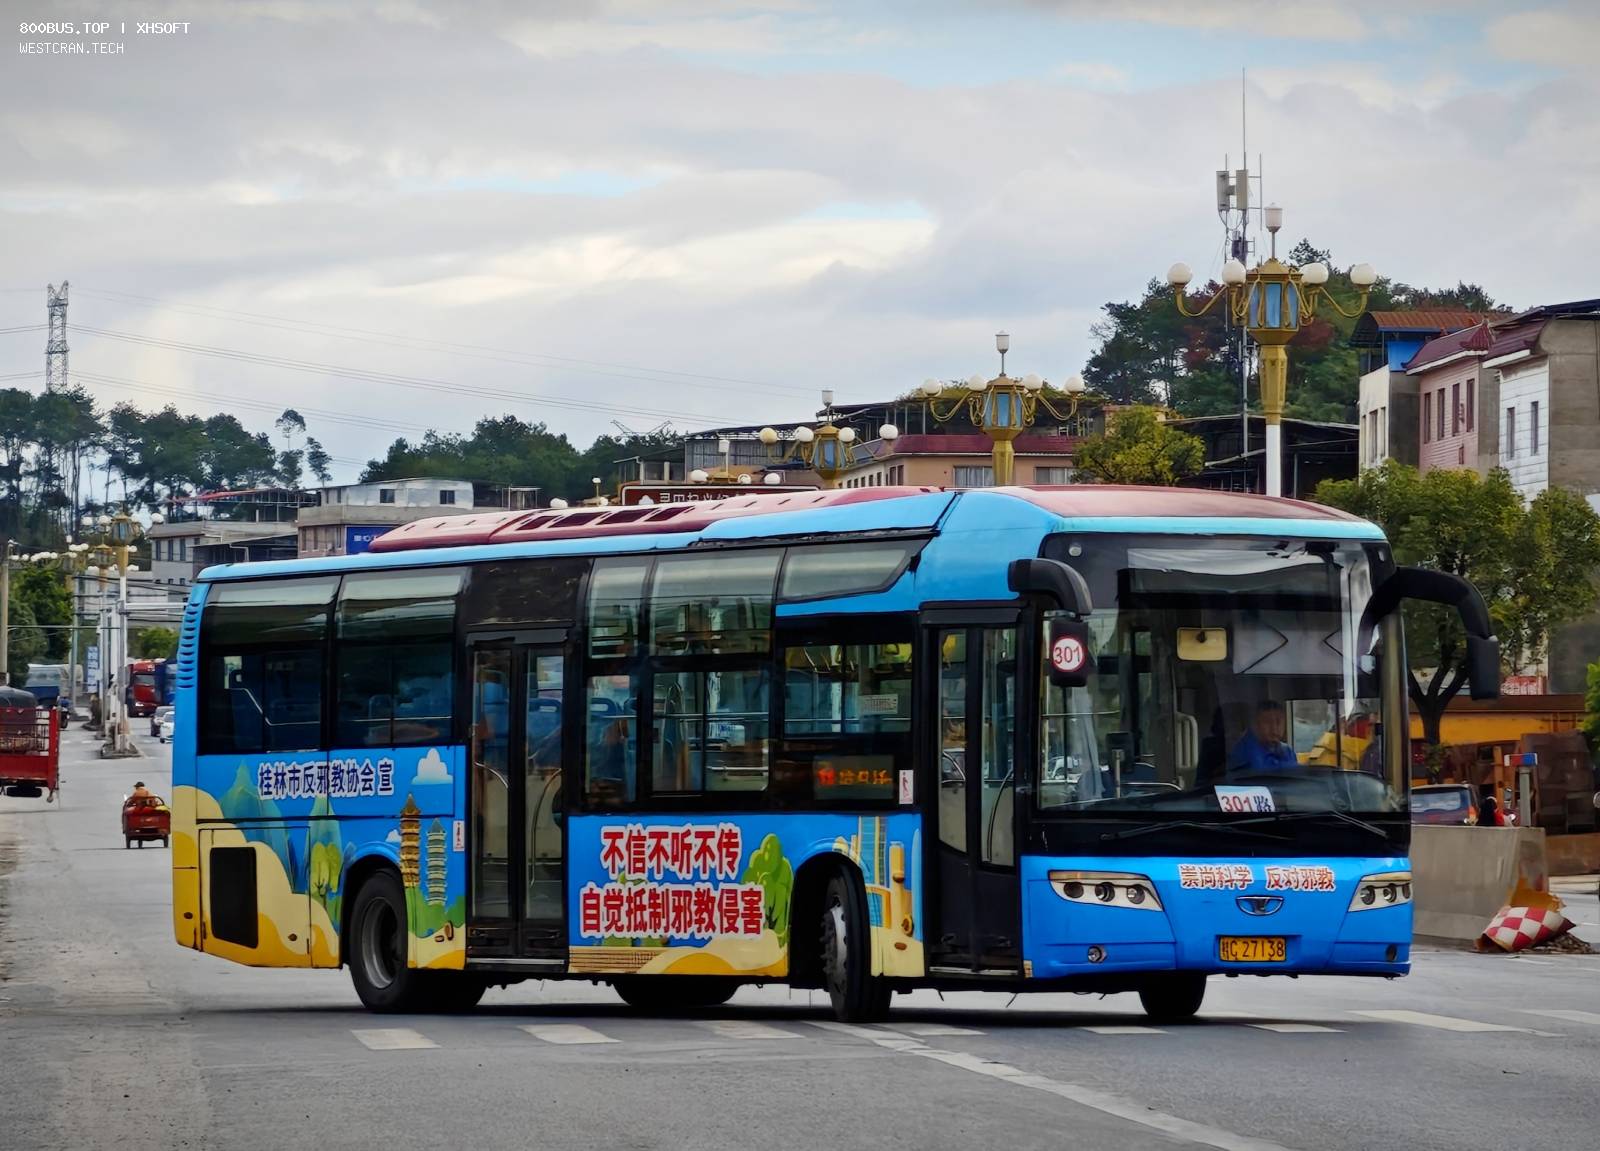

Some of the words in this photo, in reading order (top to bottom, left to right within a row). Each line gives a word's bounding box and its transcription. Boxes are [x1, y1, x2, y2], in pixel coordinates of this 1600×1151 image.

[1054, 646, 1081, 664] 301
[602, 827, 740, 876] 不信不听不传
[1180, 864, 1253, 889] 崇尚科学
[1265, 866, 1336, 891] 反对邪教
[582, 885, 764, 936] 自觉抵制邪教侵害
